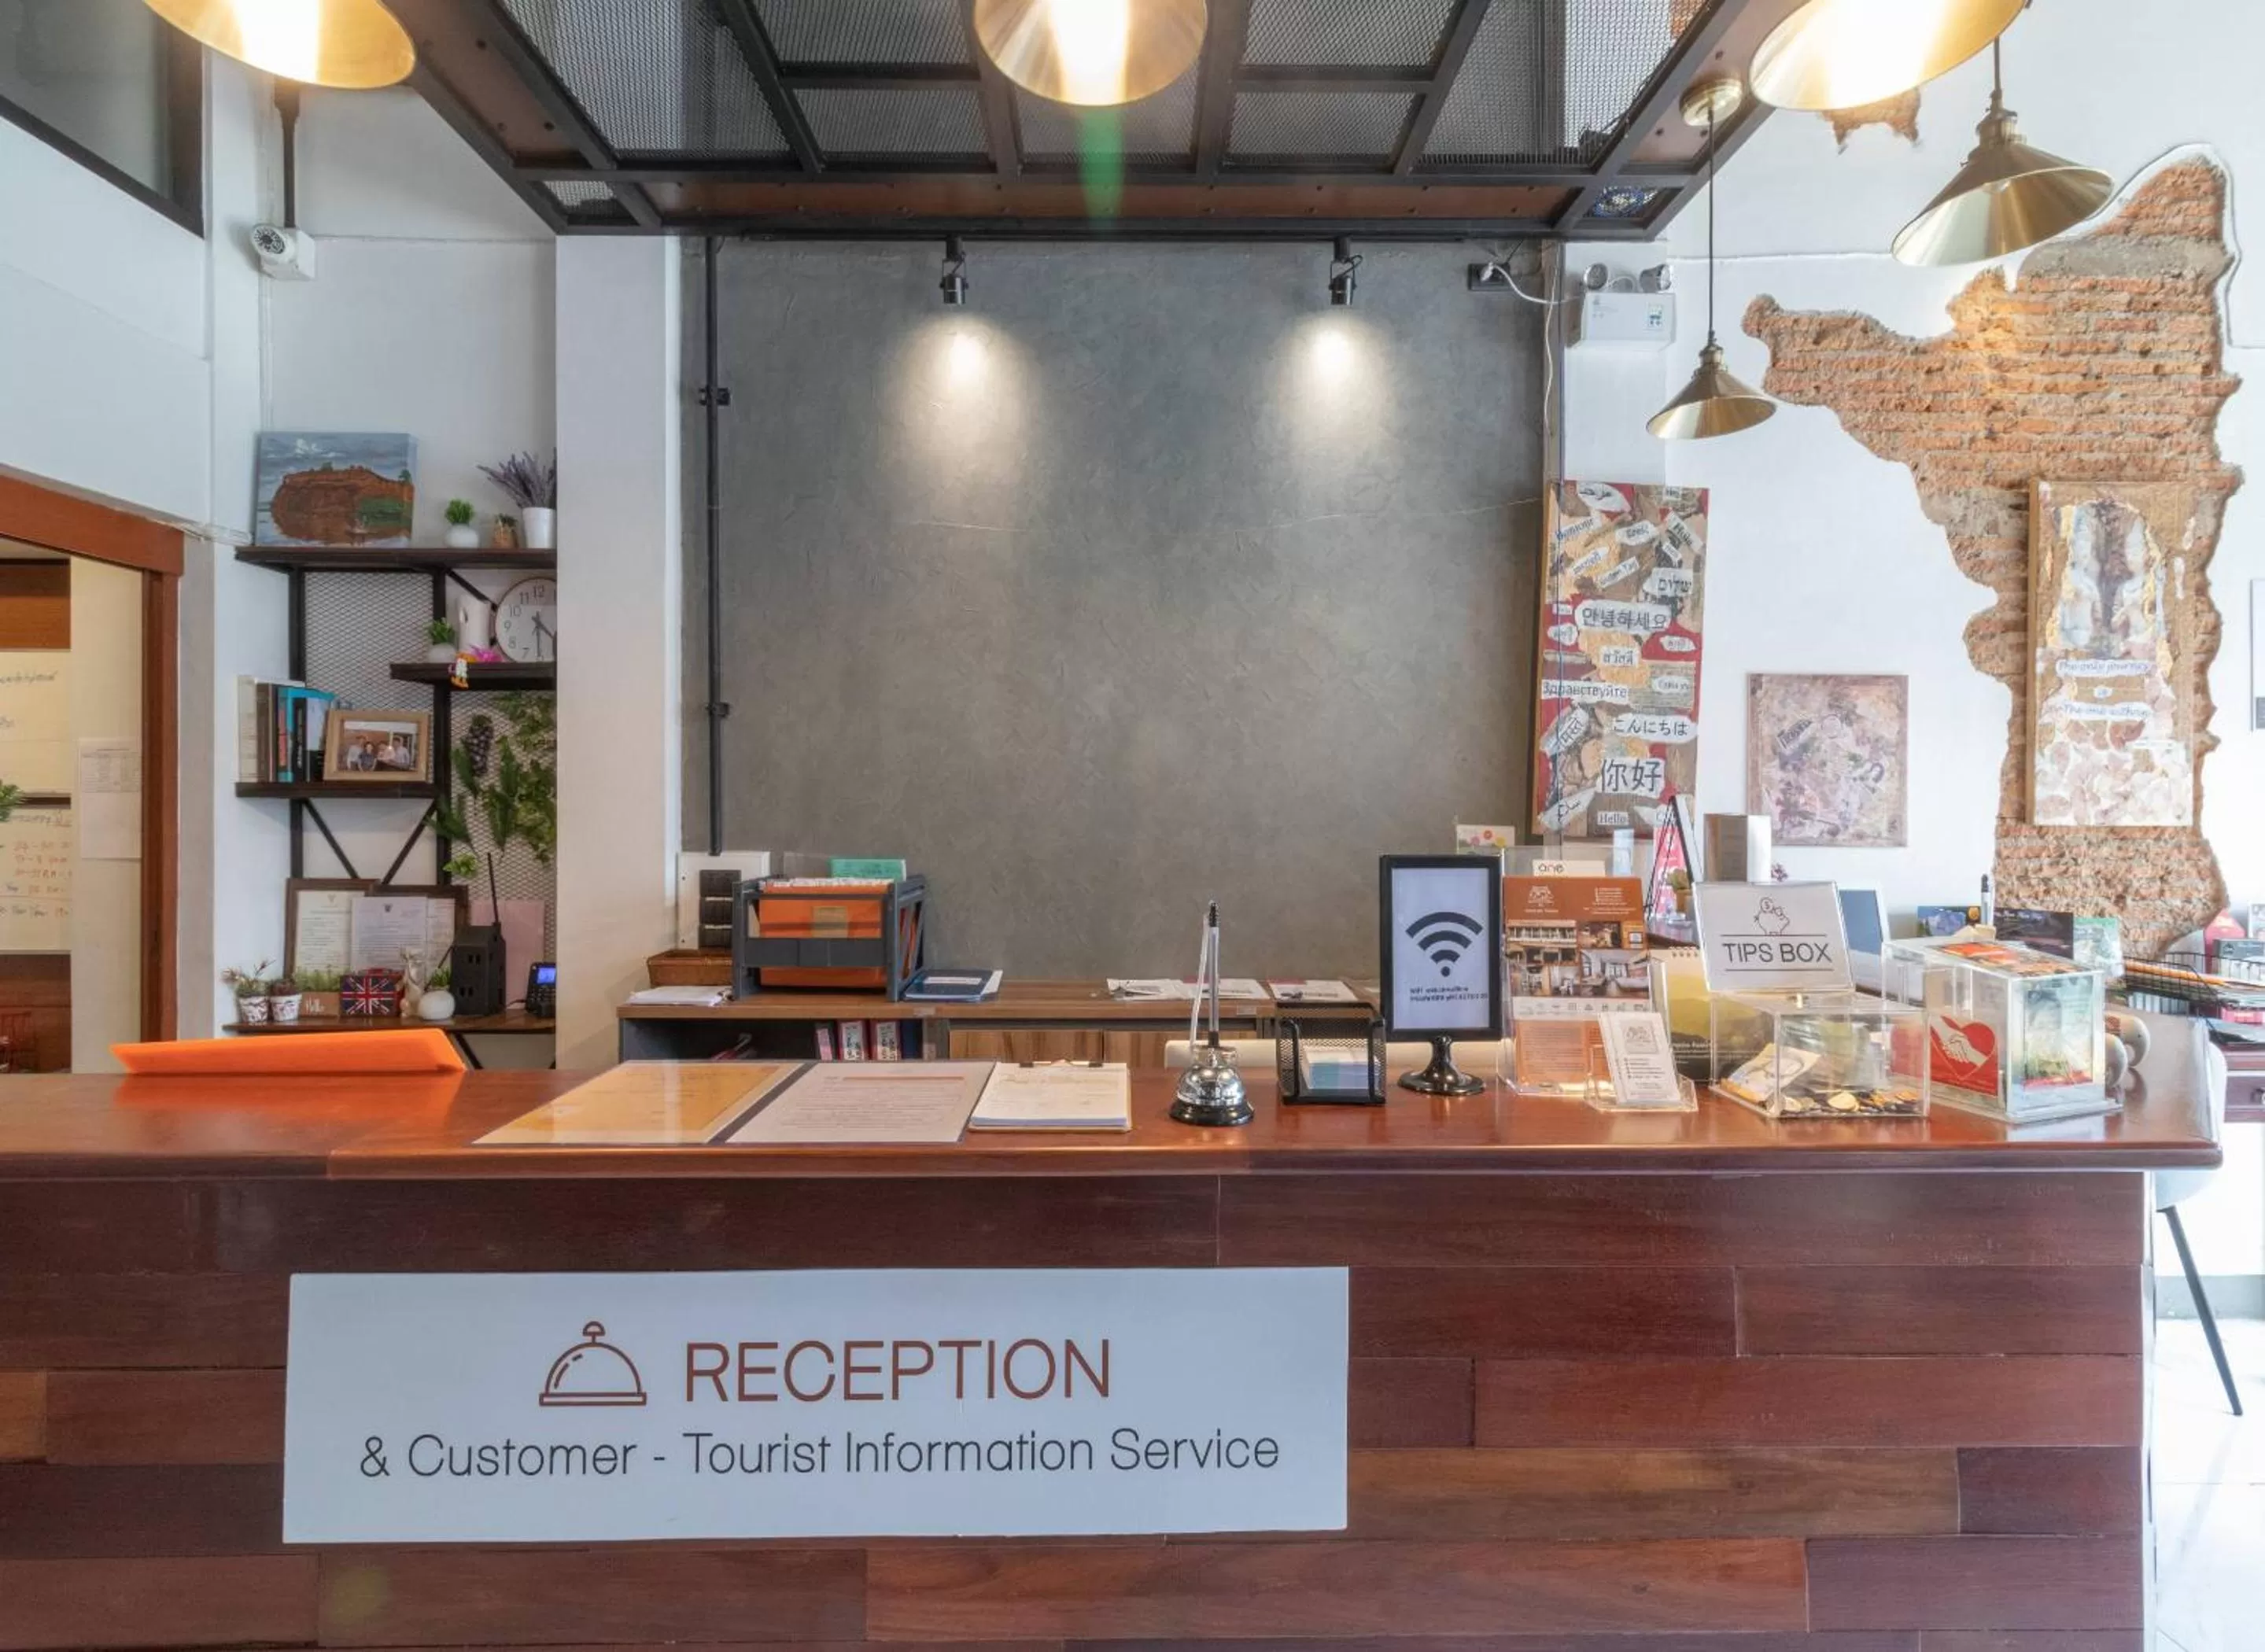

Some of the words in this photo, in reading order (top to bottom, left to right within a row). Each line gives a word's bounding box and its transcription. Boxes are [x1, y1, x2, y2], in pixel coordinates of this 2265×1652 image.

[519, 592, 529, 604] 11
[533, 585, 545, 598] 12
[508, 603, 522, 617] 10
[1581, 607, 1667, 629] 안녕하세요
[504, 620, 512, 632] 9
[522, 647, 529, 659] 7
[1543, 681, 1628, 699] Здравствуйте
[1614, 719, 1689, 736] こんにちは
[1601, 758, 1662, 792] 你好
[1599, 811, 1628, 824] Hello
[1722, 942, 1774, 963] TIPS
[1779, 942, 1833, 963] BOX
[686, 1338, 1109, 1403] RECEPTION
[360, 1435, 391, 1478] &
[408, 1433, 638, 1477] Customer
[682, 1432, 832, 1475] Tourist
[847, 1429, 1093, 1473] Information
[1110, 1427, 1279, 1471] Service
